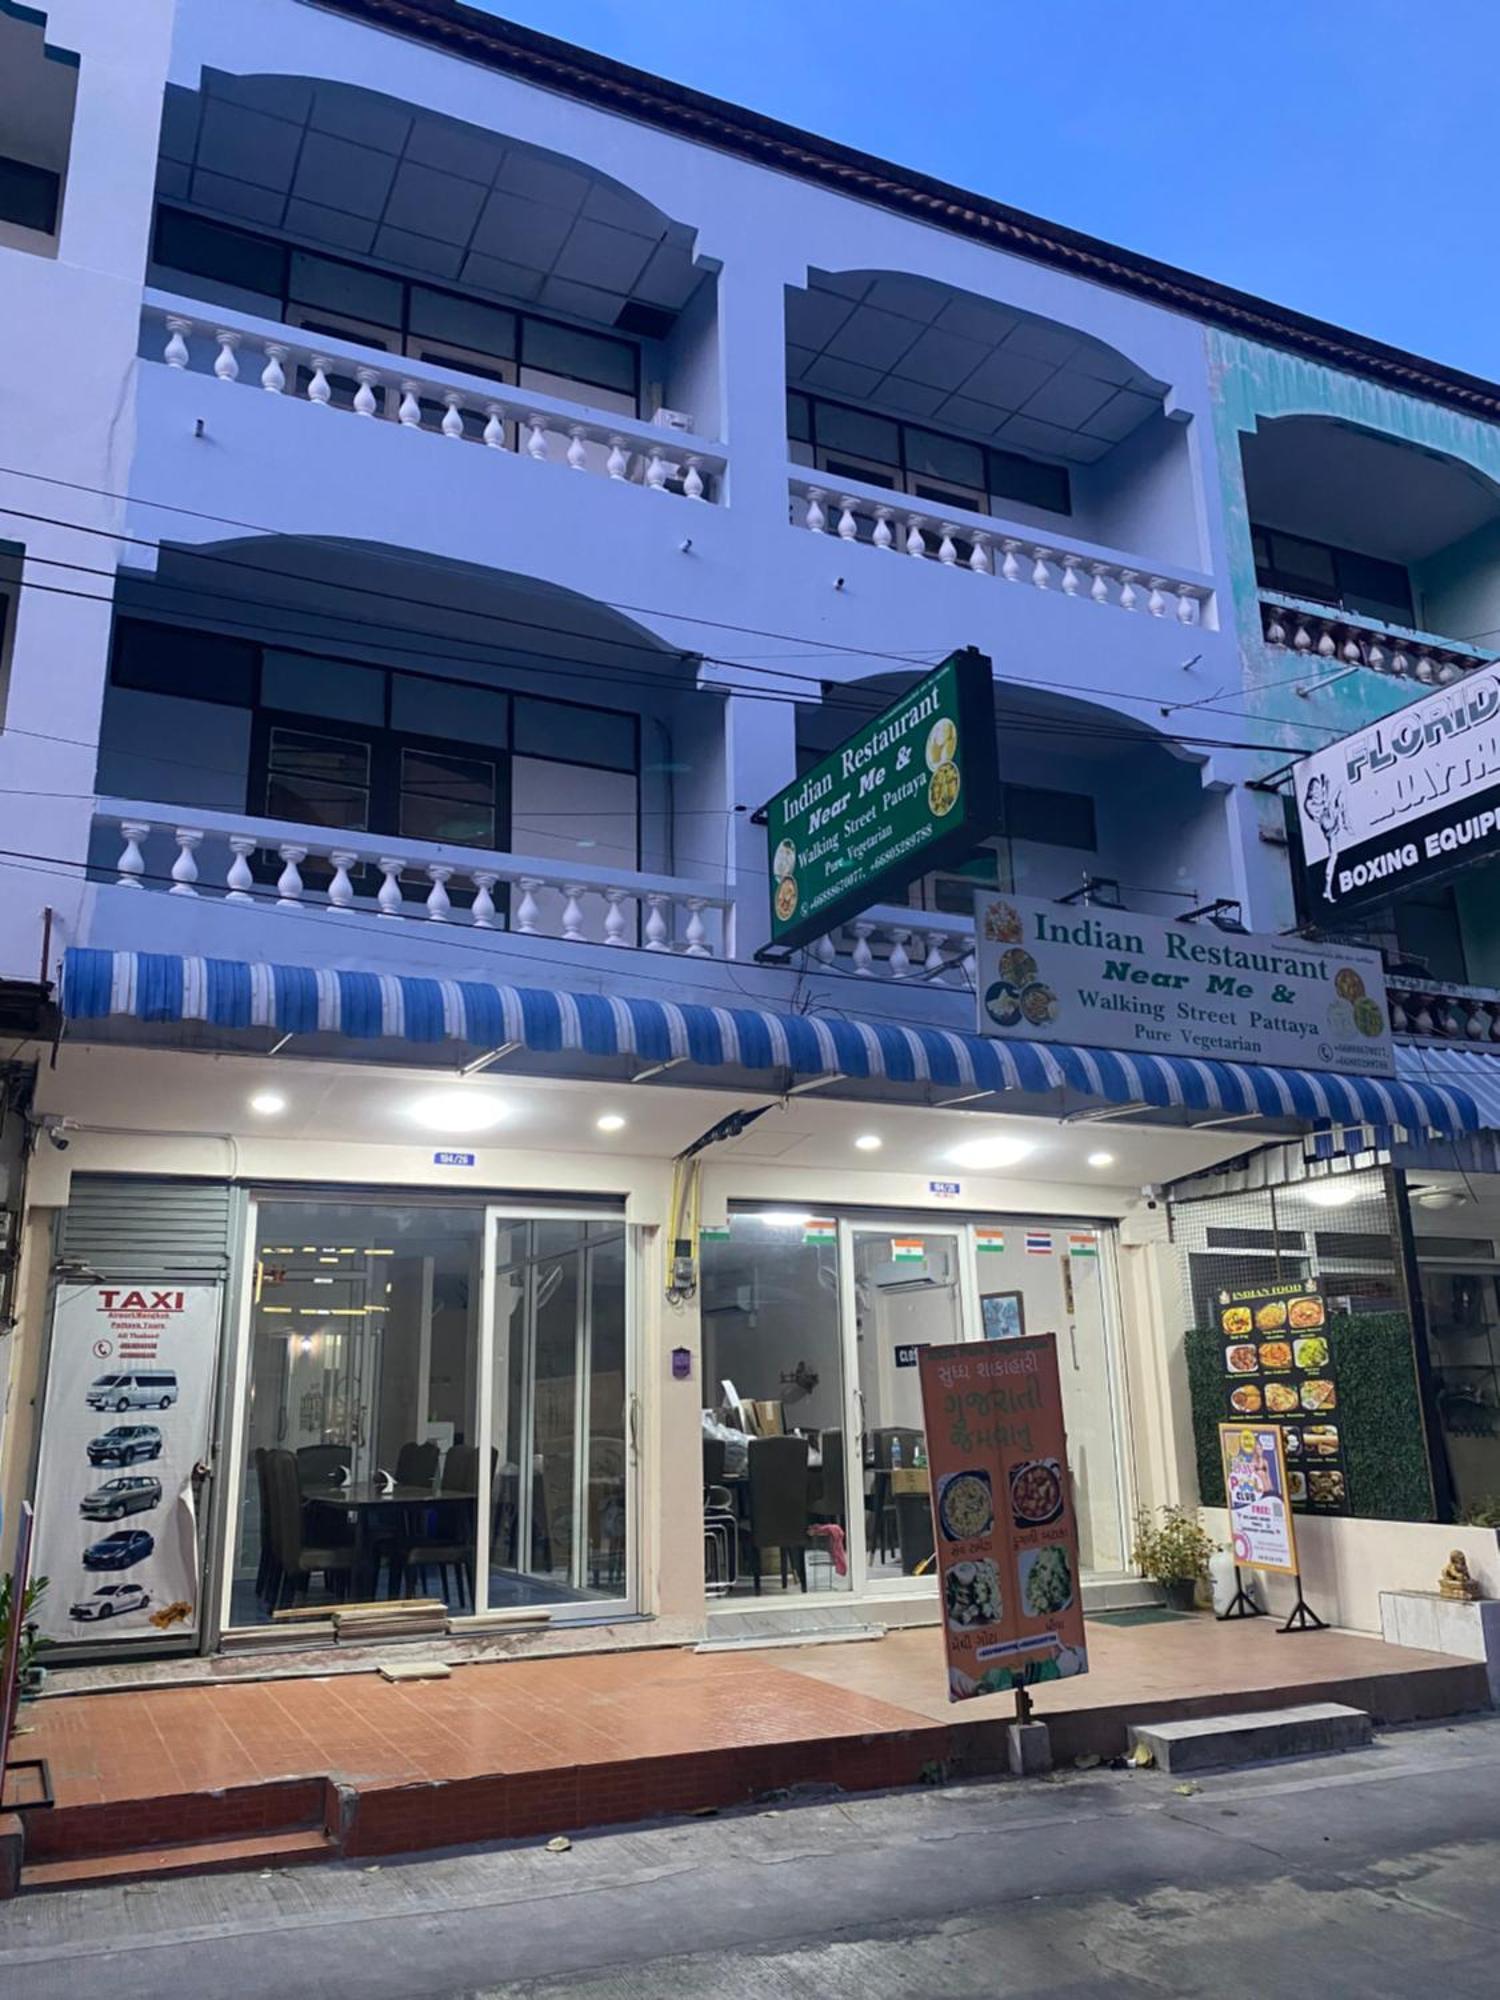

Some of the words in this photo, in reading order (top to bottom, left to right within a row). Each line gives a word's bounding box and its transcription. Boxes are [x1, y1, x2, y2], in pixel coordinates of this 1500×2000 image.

[782, 772, 833, 825] Indian
[840, 685, 941, 781] Restaurant
[808, 791, 851, 835] Near
[858, 766, 887, 799] Me
[895, 745, 912, 772] &
[798, 832, 840, 869] Walking
[844, 805, 877, 838] Street
[882, 771, 928, 813] Pattaya
[824, 857, 844, 877] Pure
[847, 824, 893, 860] Vegetarian
[1338, 843, 1419, 893] BOXING
[1033, 912, 1144, 955] Indian
[1164, 931, 1330, 982] Restaurant
[1102, 960, 1190, 991] Near
[1206, 973, 1255, 999] Me
[1271, 983, 1296, 1004] &
[1077, 988, 1166, 1022] Walking
[1176, 1001, 1237, 1027] Street
[1249, 1011, 1320, 1039] Pattaya
[1134, 1023, 1172, 1043] Pure
[1180, 1028, 1262, 1054] Vegetarian
[98, 1290, 184, 1309] TAXI
[1231, 1287, 1270, 1300] INDIAN
[1271, 1283, 1302, 1296] FOOD
